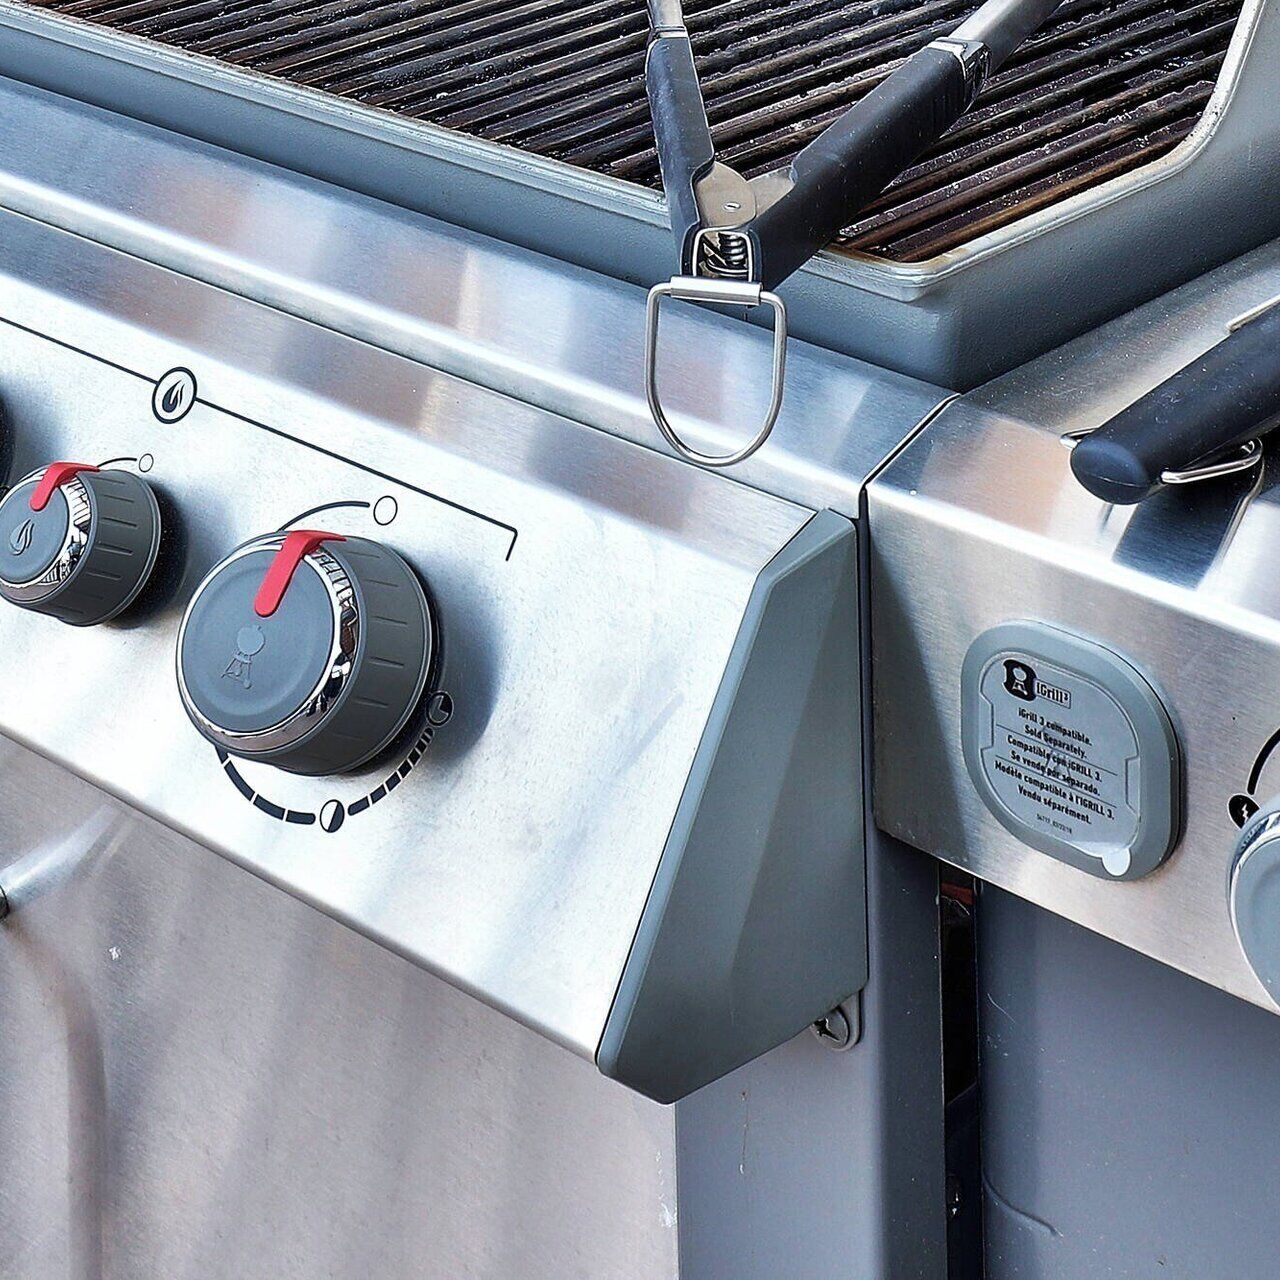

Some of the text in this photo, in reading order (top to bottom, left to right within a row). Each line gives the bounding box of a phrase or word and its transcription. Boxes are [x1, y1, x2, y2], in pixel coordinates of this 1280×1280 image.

[1025, 724, 1087, 759] Sold Separately.
[1040, 716, 1044, 726] 3
[1047, 721, 1093, 746] compatible.
[1008, 734, 1051, 760] Compatible
[1095, 771, 1102, 783] 3.
[1012, 750, 1021, 762] Se
[1022, 757, 1046, 773] vende
[995, 760, 1023, 780] Modèle
[1024, 775, 1067, 799] compatible
[1106, 809, 1114, 820] 3.
[1018, 784, 1042, 802] Vendu
